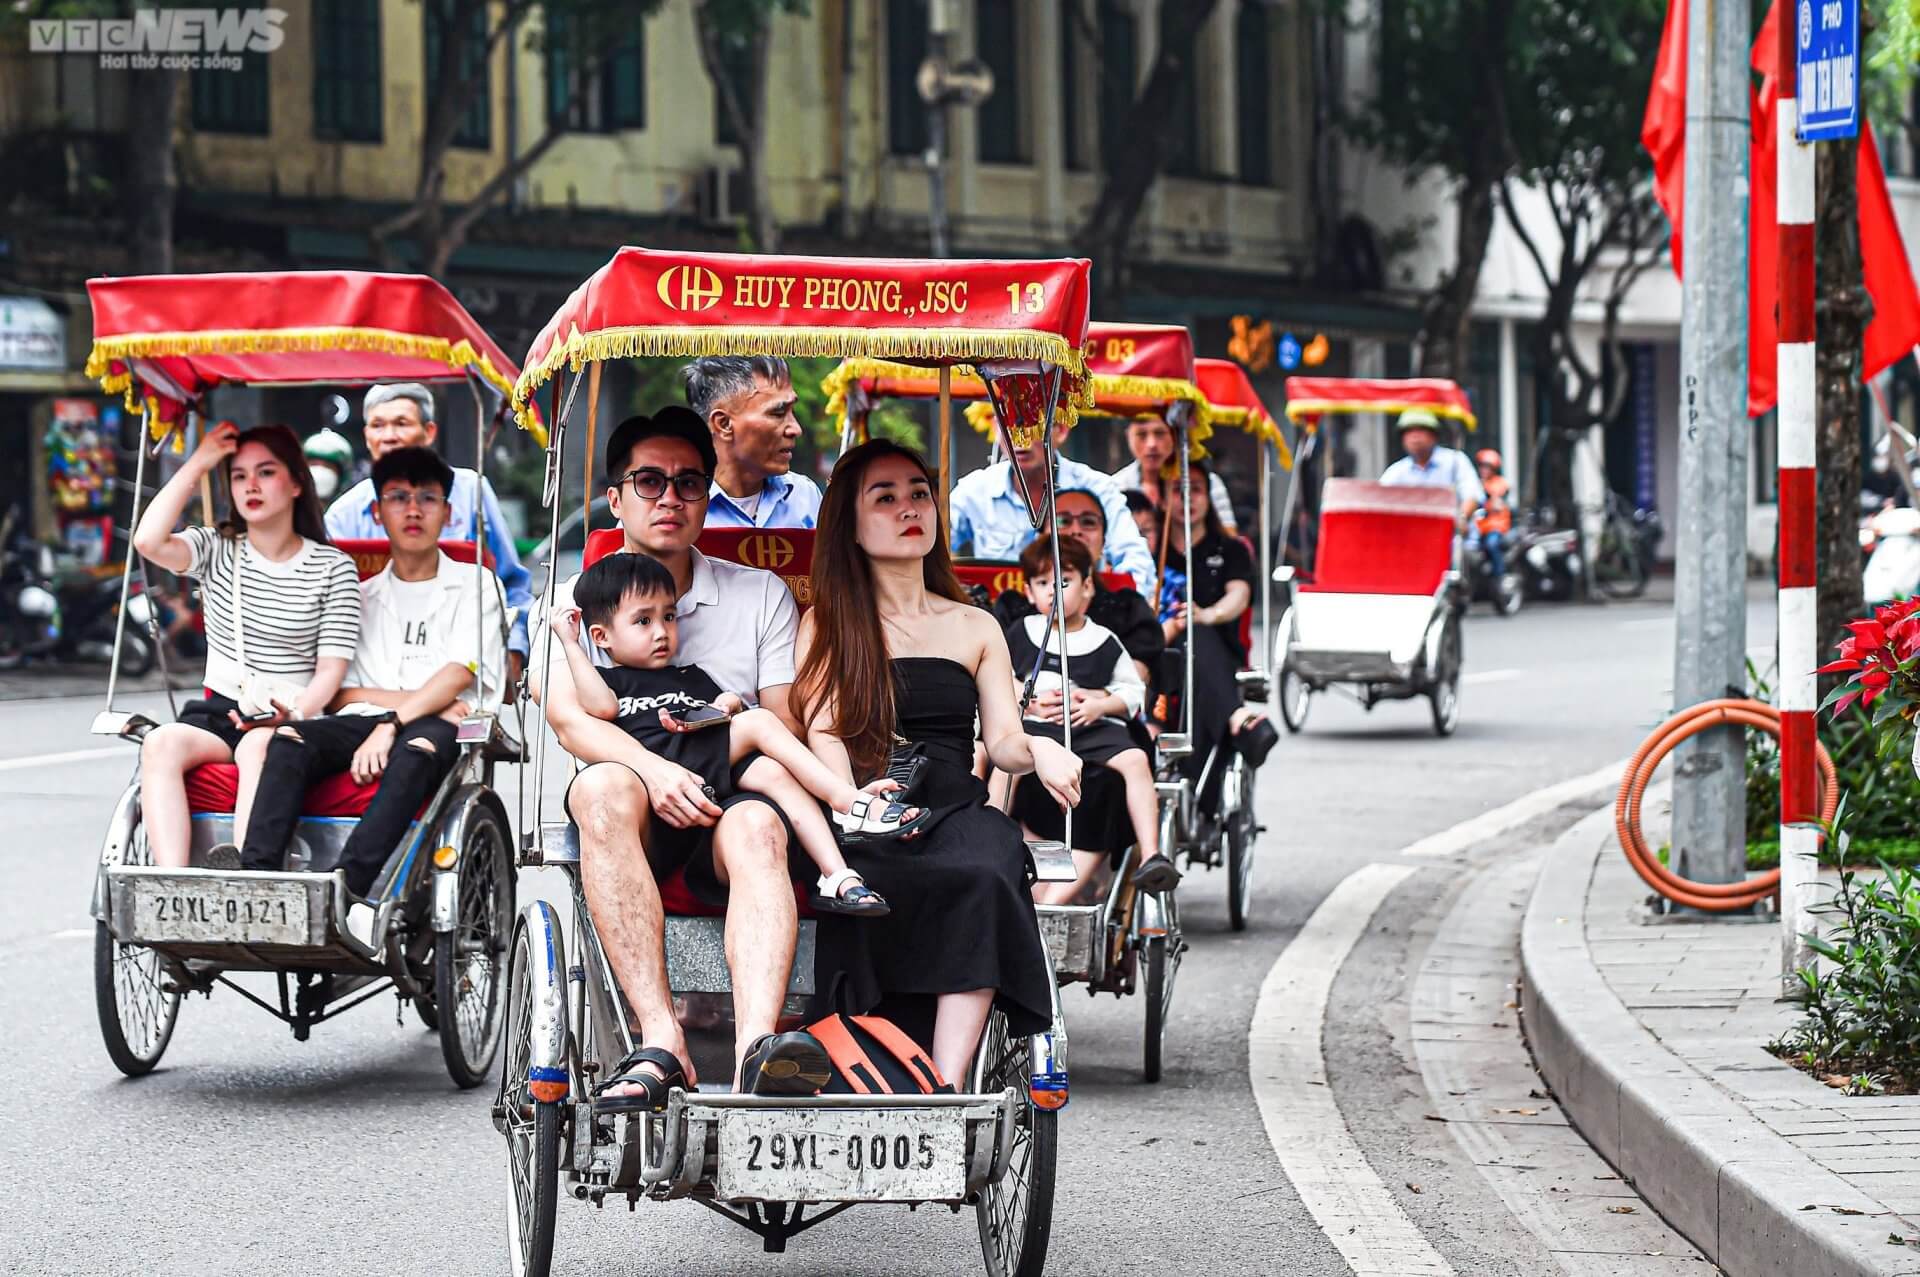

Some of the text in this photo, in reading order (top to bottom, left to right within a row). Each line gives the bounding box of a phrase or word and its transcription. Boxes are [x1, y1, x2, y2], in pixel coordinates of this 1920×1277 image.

[733, 275, 796, 309] HUY
[1006, 282, 1045, 315] 13
[1105, 338, 1136, 363] 03
[403, 620, 427, 647] LA
[155, 895, 288, 926] 29XL-0121
[746, 1132, 936, 1171] 29XL-0005
